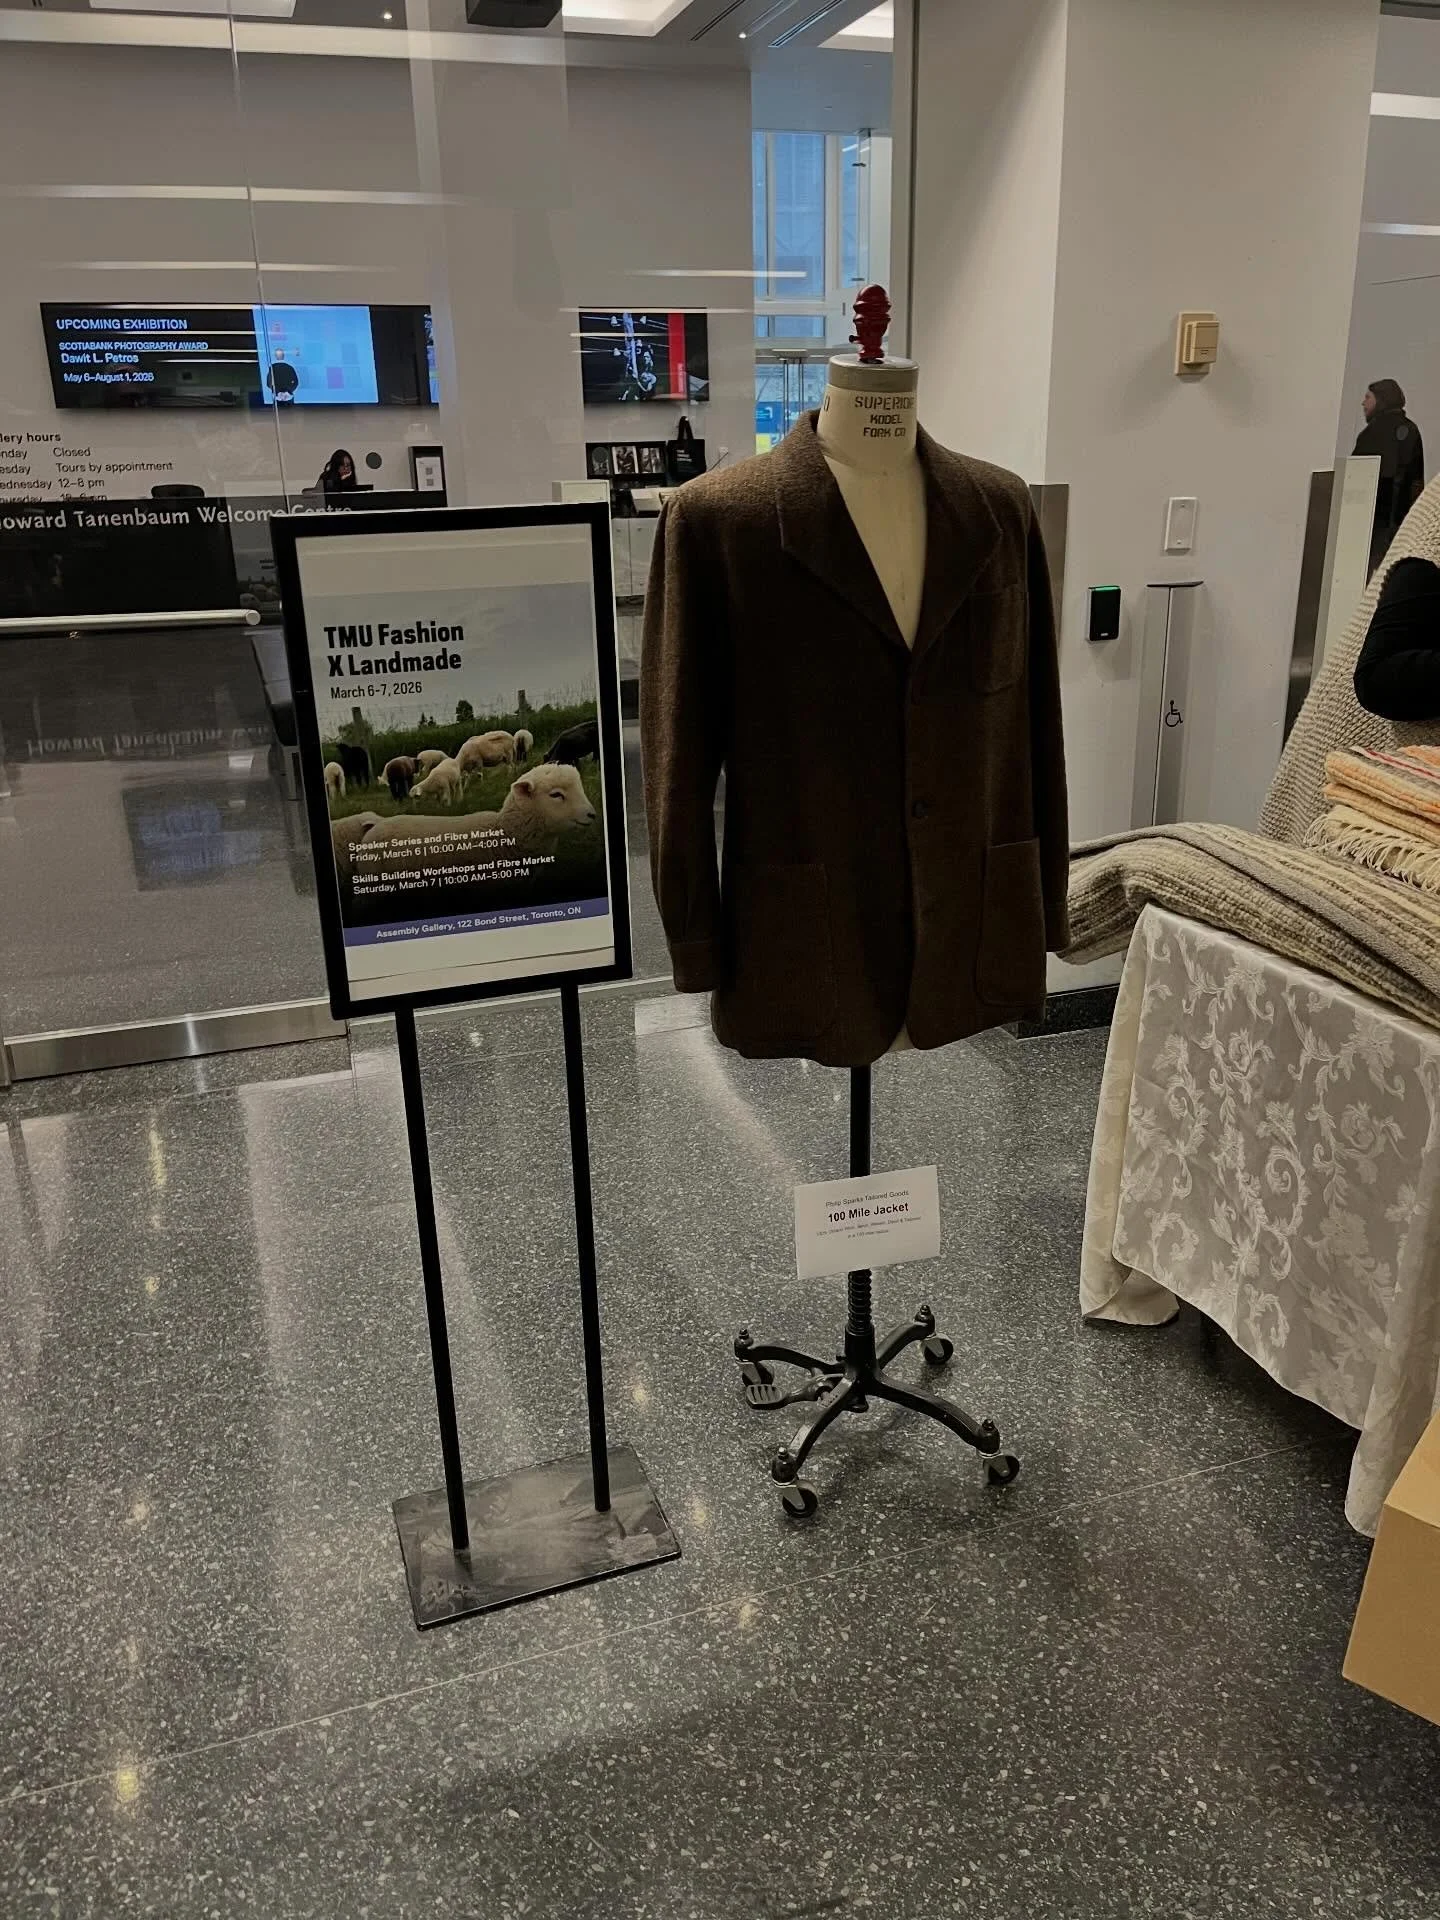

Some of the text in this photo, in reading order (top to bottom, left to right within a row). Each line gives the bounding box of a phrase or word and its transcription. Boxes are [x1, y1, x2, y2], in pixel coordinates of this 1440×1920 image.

[56, 319, 187, 330] UPCOMING EXHIBITION
[59, 342, 208, 350] SCOTIABANK PHOTOGRAPHY AWARD
[61, 353, 139, 364] Dawit L. Petros
[64, 373, 82, 384] May
[125, 373, 131, 383] 1,
[27, 433, 61, 442] hours
[53, 447, 91, 457] Closed
[56, 463, 86, 472] Tours
[89, 462, 102, 474] by
[106, 462, 173, 474] appointment
[88, 480, 105, 490] pm
[0, 508, 66, 530] oward
[73, 507, 190, 529] Tanenbaum
[324, 620, 464, 648] TMU Fashion
[328, 648, 462, 677] X Landmade
[331, 685, 366, 700] March
[393, 682, 422, 695] 2026
[348, 828, 504, 852] Speaker Series and Fibre Market
[350, 852, 381, 862] Friday,
[383, 848, 412, 859] March
[414, 848, 421, 856] 6
[429, 844, 454, 854] 10:00
[500, 838, 516, 846] PM
[352, 855, 556, 884] Skills Building Workshops and Fibre Market
[354, 884, 397, 895] Saturday,
[400, 880, 428, 890] March
[430, 878, 436, 886] 7
[444, 874, 468, 885] 10:00
[514, 868, 530, 877] PM
[376, 906, 582, 938] Assembly Gallery, 122 Bond Street, Toronto, ON
[843, 1197, 864, 1205] Sparks
[889, 1190, 909, 1198] Goods
[828, 1202, 909, 1222] 100 Mile Jacket
